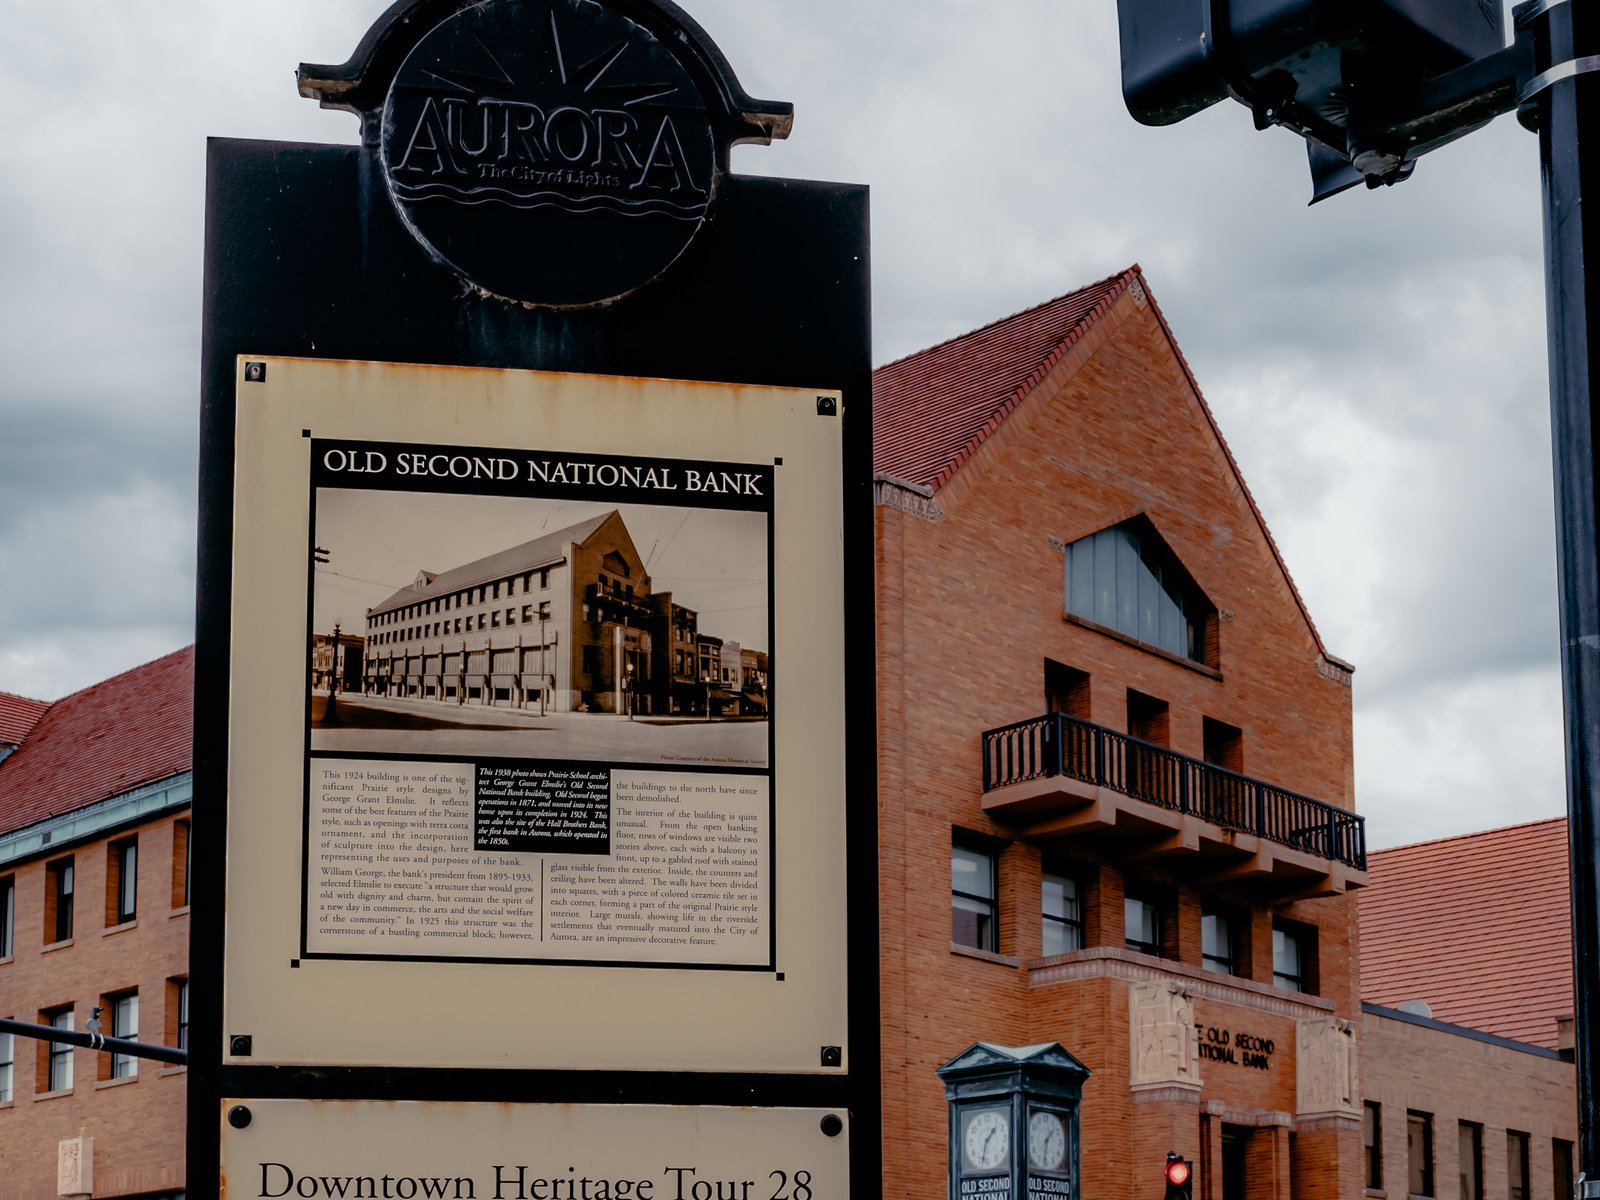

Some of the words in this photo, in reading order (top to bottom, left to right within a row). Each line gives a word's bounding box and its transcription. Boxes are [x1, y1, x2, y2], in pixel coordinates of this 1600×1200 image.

[391, 97, 706, 194] AURORA
[324, 450, 387, 473] OLD
[396, 453, 518, 480] SECOND
[527, 461, 677, 489] NATIONAL
[685, 470, 763, 495] BANK
[323, 771, 341, 779] This
[345, 771, 364, 780] 1924
[367, 772, 400, 783] building
[429, 774, 438, 782] of
[440, 775, 453, 783] the
[455, 776, 469, 786] sig-
[322, 782, 354, 791] nificant
[362, 784, 389, 792] Prairie
[396, 785, 415, 796] style
[422, 786, 451, 797] designs
[459, 787, 469, 798] by
[616, 781, 629, 790] the
[632, 782, 667, 794] buildings
[680, 784, 693, 792] the
[696, 785, 716, 793] north
[720, 786, 737, 794] have
[322, 794, 351, 805] George
[357, 795, 380, 804] Grant
[386, 796, 417, 805] Elmslie.
[430, 798, 436, 806] It
[442, 798, 469, 807] reflects
[616, 793, 634, 801] been
[636, 794, 682, 803] demolished.
[344, 806, 353, 814] of
[355, 806, 368, 815] the
[370, 807, 385, 815] best
[387, 808, 417, 816] features
[419, 809, 428, 817] of
[429, 809, 442, 817] the
[444, 810, 469, 818] Prairie
[616, 807, 632, 816] The
[636, 809, 664, 817] interior
[667, 810, 675, 818] of
[679, 810, 691, 818] the
[694, 811, 726, 822] building
[739, 814, 758, 823] quite
[322, 817, 342, 828] style,
[344, 818, 362, 826] such
[373, 820, 408, 830] openings
[410, 820, 428, 828] with
[449, 822, 469, 830] cotta
[616, 819, 648, 828] unusual.
[660, 820, 680, 829] From
[686, 822, 698, 830] the
[703, 824, 722, 833] open
[728, 823, 758, 835] banking
[322, 830, 365, 839] ornament,
[371, 830, 387, 839] and
[392, 831, 406, 839] the
[411, 833, 469, 844] incorporation
[321, 840, 330, 848] of
[334, 841, 374, 852] sculpture
[378, 843, 395, 851] into
[399, 843, 413, 851] the
[417, 843, 446, 855] design,
[451, 844, 469, 853] here
[321, 853, 374, 864] representing
[377, 854, 390, 862] the
[413, 855, 429, 863] and
[432, 858, 469, 867] purposes
[472, 857, 483, 865] of
[484, 857, 496, 865] the
[500, 858, 522, 866] bank.
[550, 921, 593, 930] settlements
[597, 922, 612, 931] that
[616, 923, 655, 934] eventually
[659, 924, 690, 933] matured
[694, 926, 710, 934] into
[714, 926, 726, 934] the
[730, 926, 747, 937] City
[750, 927, 760, 935] of
[550, 932, 579, 942] Aurora,
[608, 935, 647, 945] impressive
[649, 935, 687, 944] decorative
[690, 936, 717, 945] feature.
[1207, 1027, 1229, 1045] OLD
[1235, 1033, 1274, 1055] SECOND
[1198, 1042, 1238, 1065] TIONAL
[1243, 1051, 1269, 1070] BANK
[258, 1163, 477, 1200] Downtown
[962, 1181, 977, 1193] OLD
[978, 1178, 1010, 1191] SECOND
[1028, 1178, 1042, 1190] OLD
[1043, 1179, 1070, 1194] SECOND
